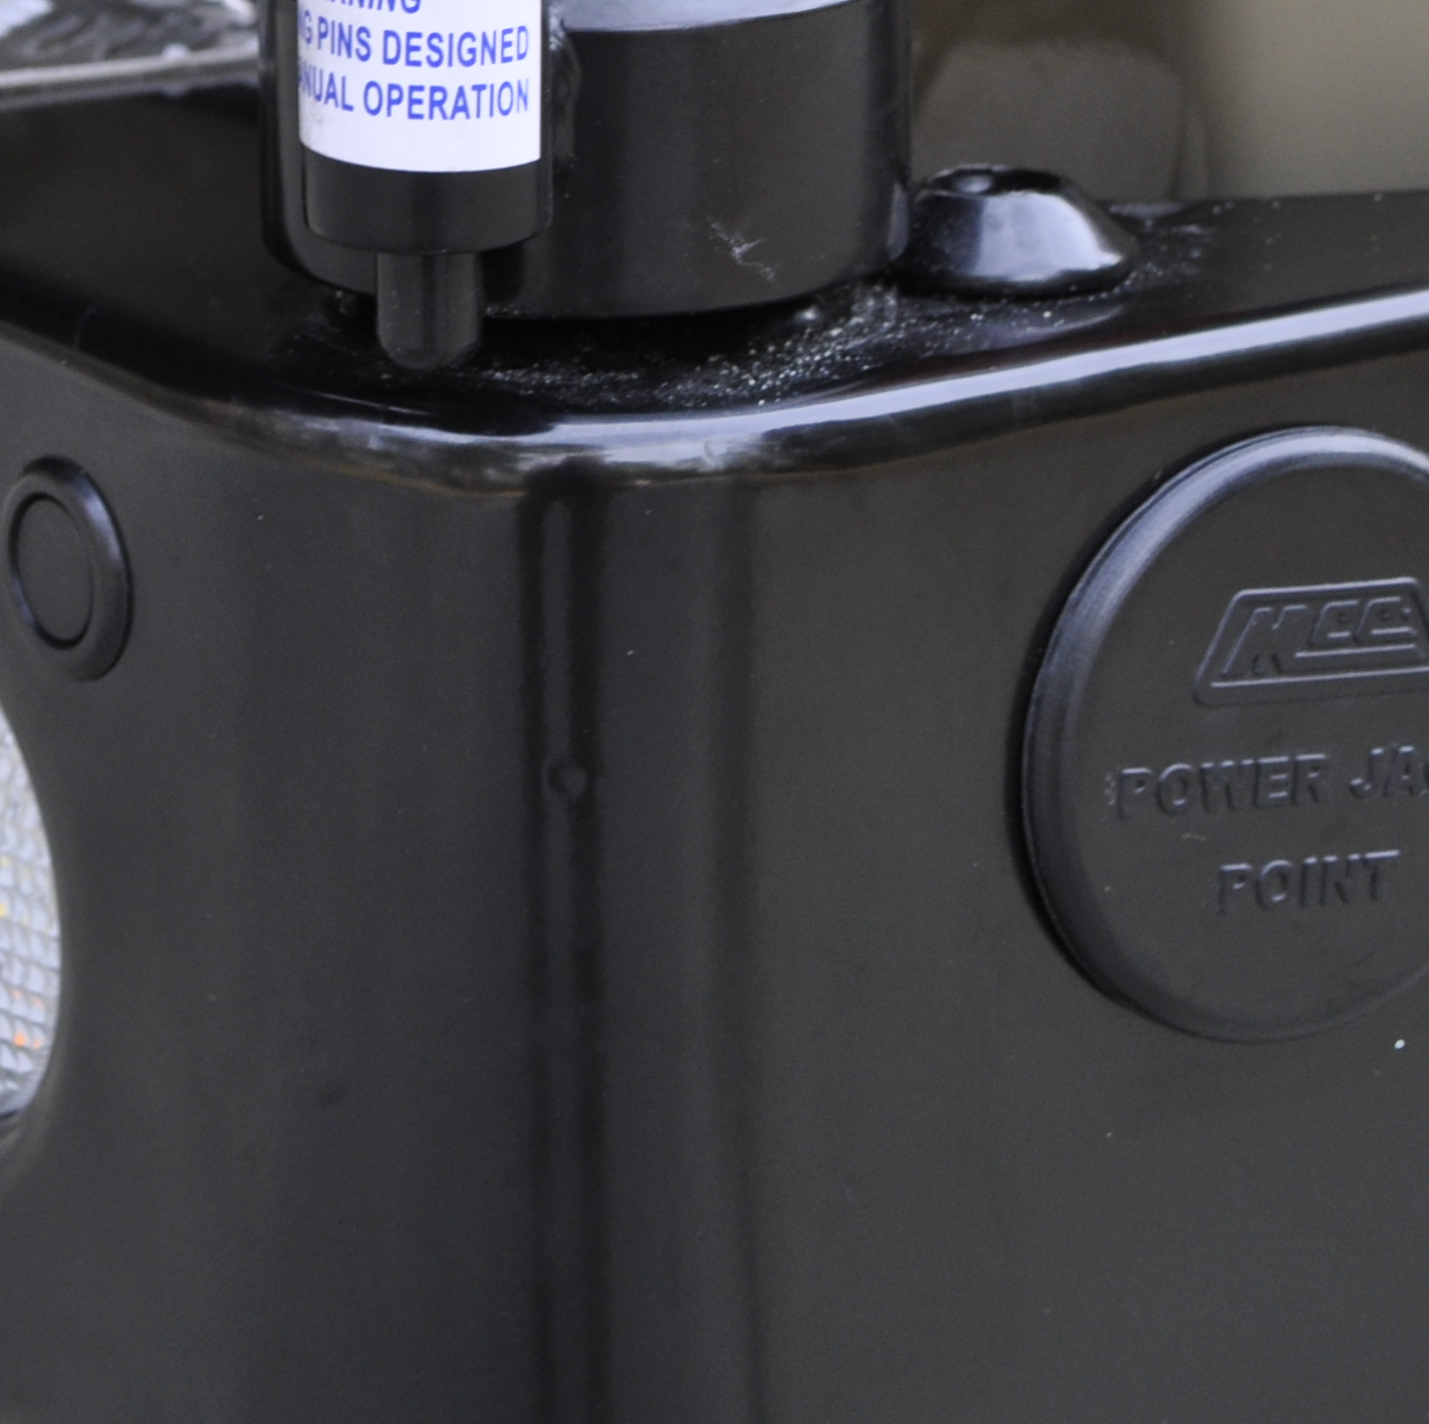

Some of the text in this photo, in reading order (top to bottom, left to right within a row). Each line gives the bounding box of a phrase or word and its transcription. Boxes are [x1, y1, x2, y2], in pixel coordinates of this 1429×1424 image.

[317, 15, 372, 62] PINS
[382, 25, 529, 68] DESIGNED
[363, 77, 530, 120] OPERATION
[1115, 744, 1429, 820] POWER JA
[1216, 849, 1402, 916] POINT
